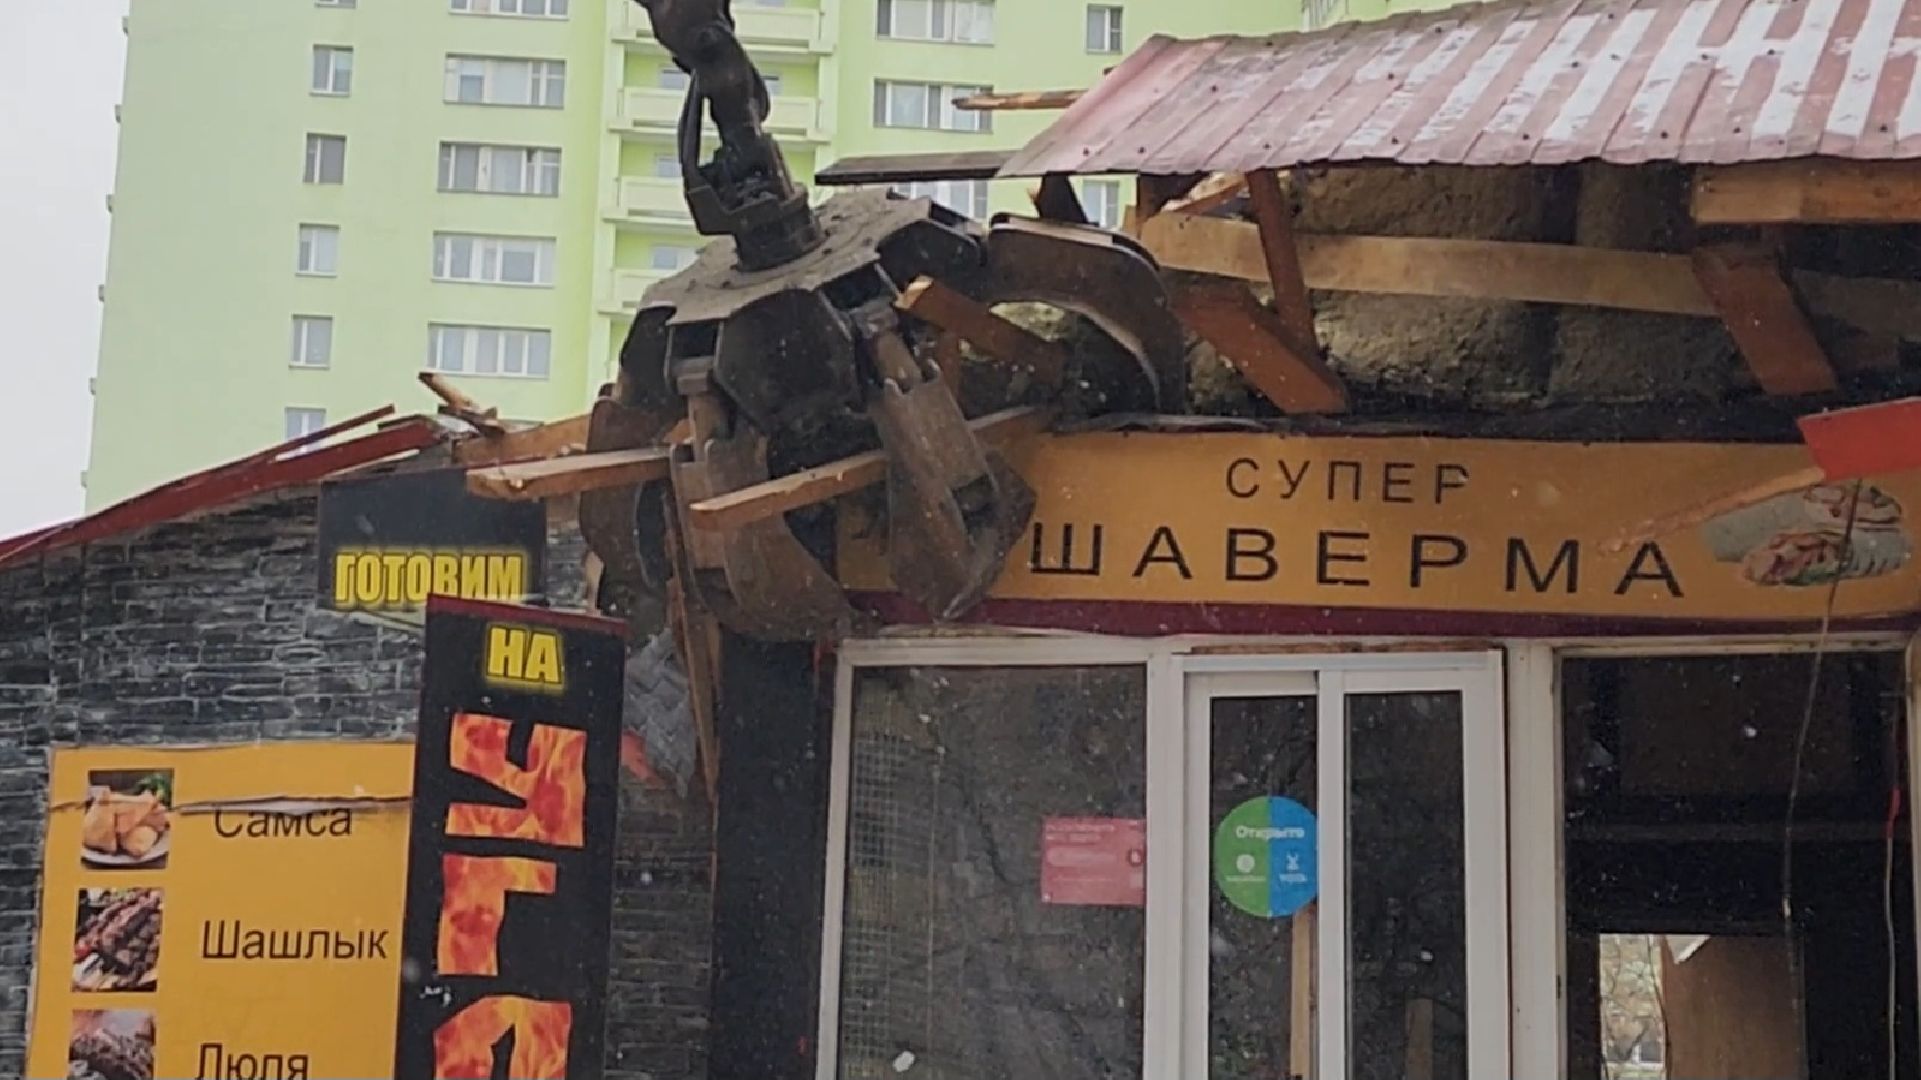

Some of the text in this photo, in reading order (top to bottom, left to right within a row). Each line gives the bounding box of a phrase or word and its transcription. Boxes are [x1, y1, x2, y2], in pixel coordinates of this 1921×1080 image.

[1226, 457, 1469, 504] СУПЕР
[332, 551, 525, 603] ГОТОВИМ
[1029, 522, 1684, 598] ШАВЕРМА
[485, 625, 562, 684] НА
[213, 806, 353, 839] Самса
[201, 919, 390, 960] Шашлык
[194, 1041, 310, 1080] Люля
